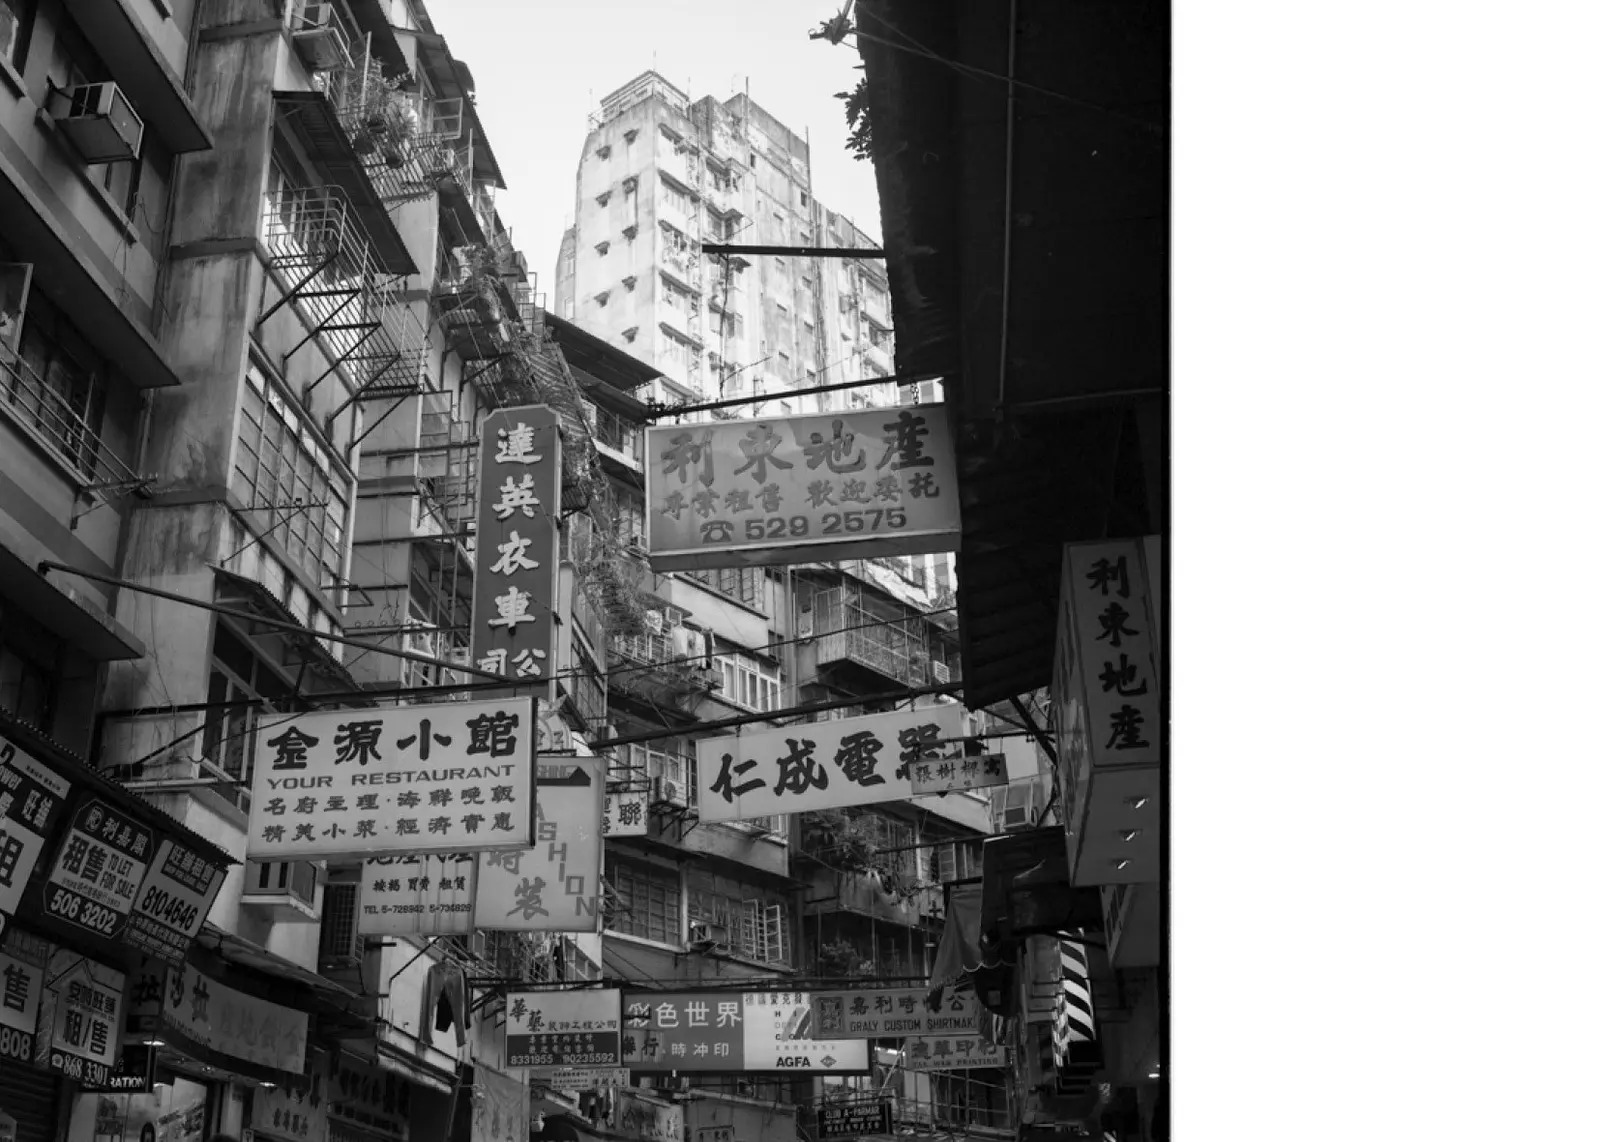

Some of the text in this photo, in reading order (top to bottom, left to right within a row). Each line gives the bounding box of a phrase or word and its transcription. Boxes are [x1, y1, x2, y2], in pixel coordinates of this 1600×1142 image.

[659, 410, 935, 488] 利東地產
[745, 506, 907, 540] 529 2575
[1086, 555, 1150, 752] 利東地產
[267, 711, 519, 771] 金源小館
[267, 775, 333, 791] YOUR
[351, 765, 516, 787] RESTAURANT
[710, 723, 947, 804] 仁成電器
[62, 835, 107, 884] 租售
[51, 888, 80, 918] 506
[80, 902, 117, 934] 3202
[142, 885, 198, 930] 8104646
[364, 905, 378, 915] TEL
[4, 964, 30, 1013] 售
[850, 994, 966, 1015] 嘉利時公
[628, 1001, 742, 1028] 彩色世界
[885, 1019, 921, 1032] CUSTOM
[1, 1027, 31, 1061] 808
[776, 1056, 811, 1068] AGFA
